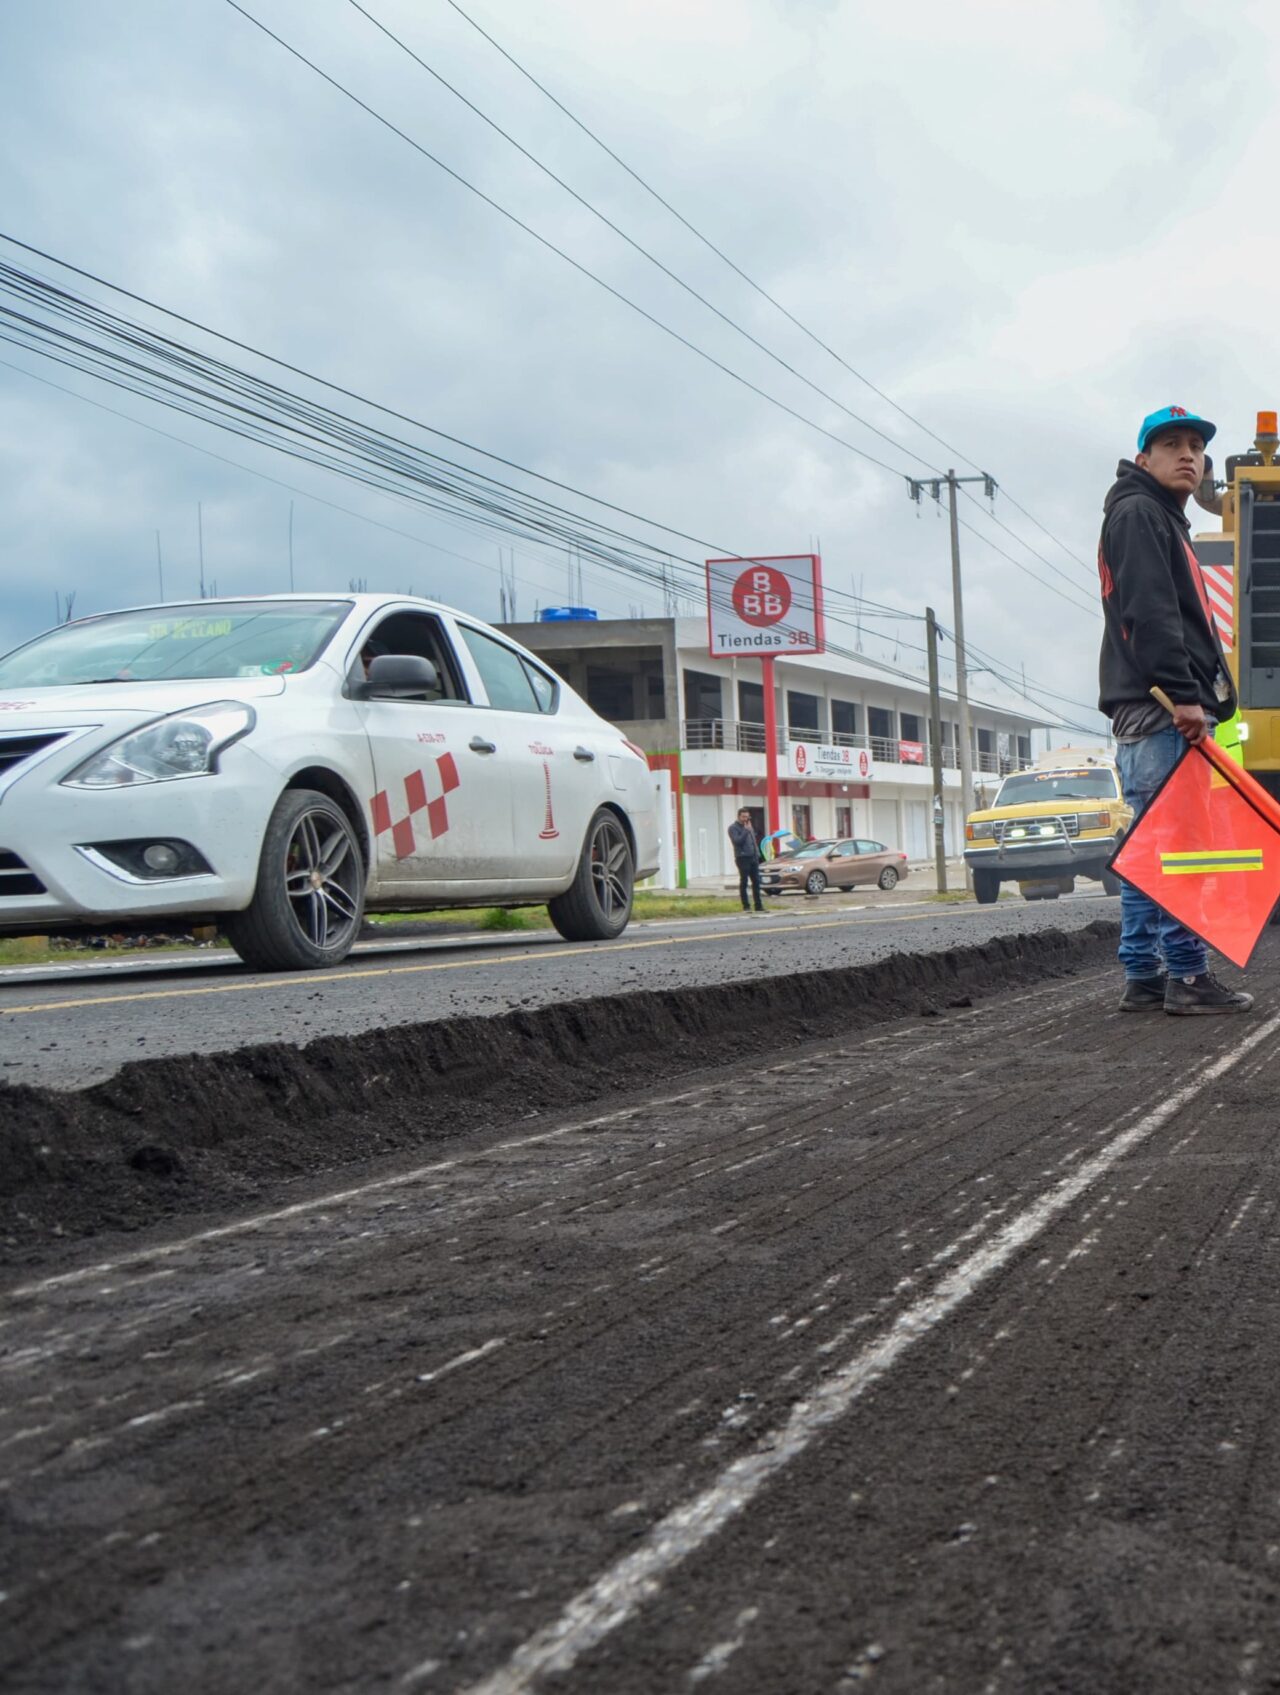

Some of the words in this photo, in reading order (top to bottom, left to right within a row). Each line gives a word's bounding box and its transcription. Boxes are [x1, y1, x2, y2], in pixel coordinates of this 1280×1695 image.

[717, 633, 782, 648] Tiendas
[788, 630, 809, 645] 3B
[817, 746, 840, 761] Tiendas
